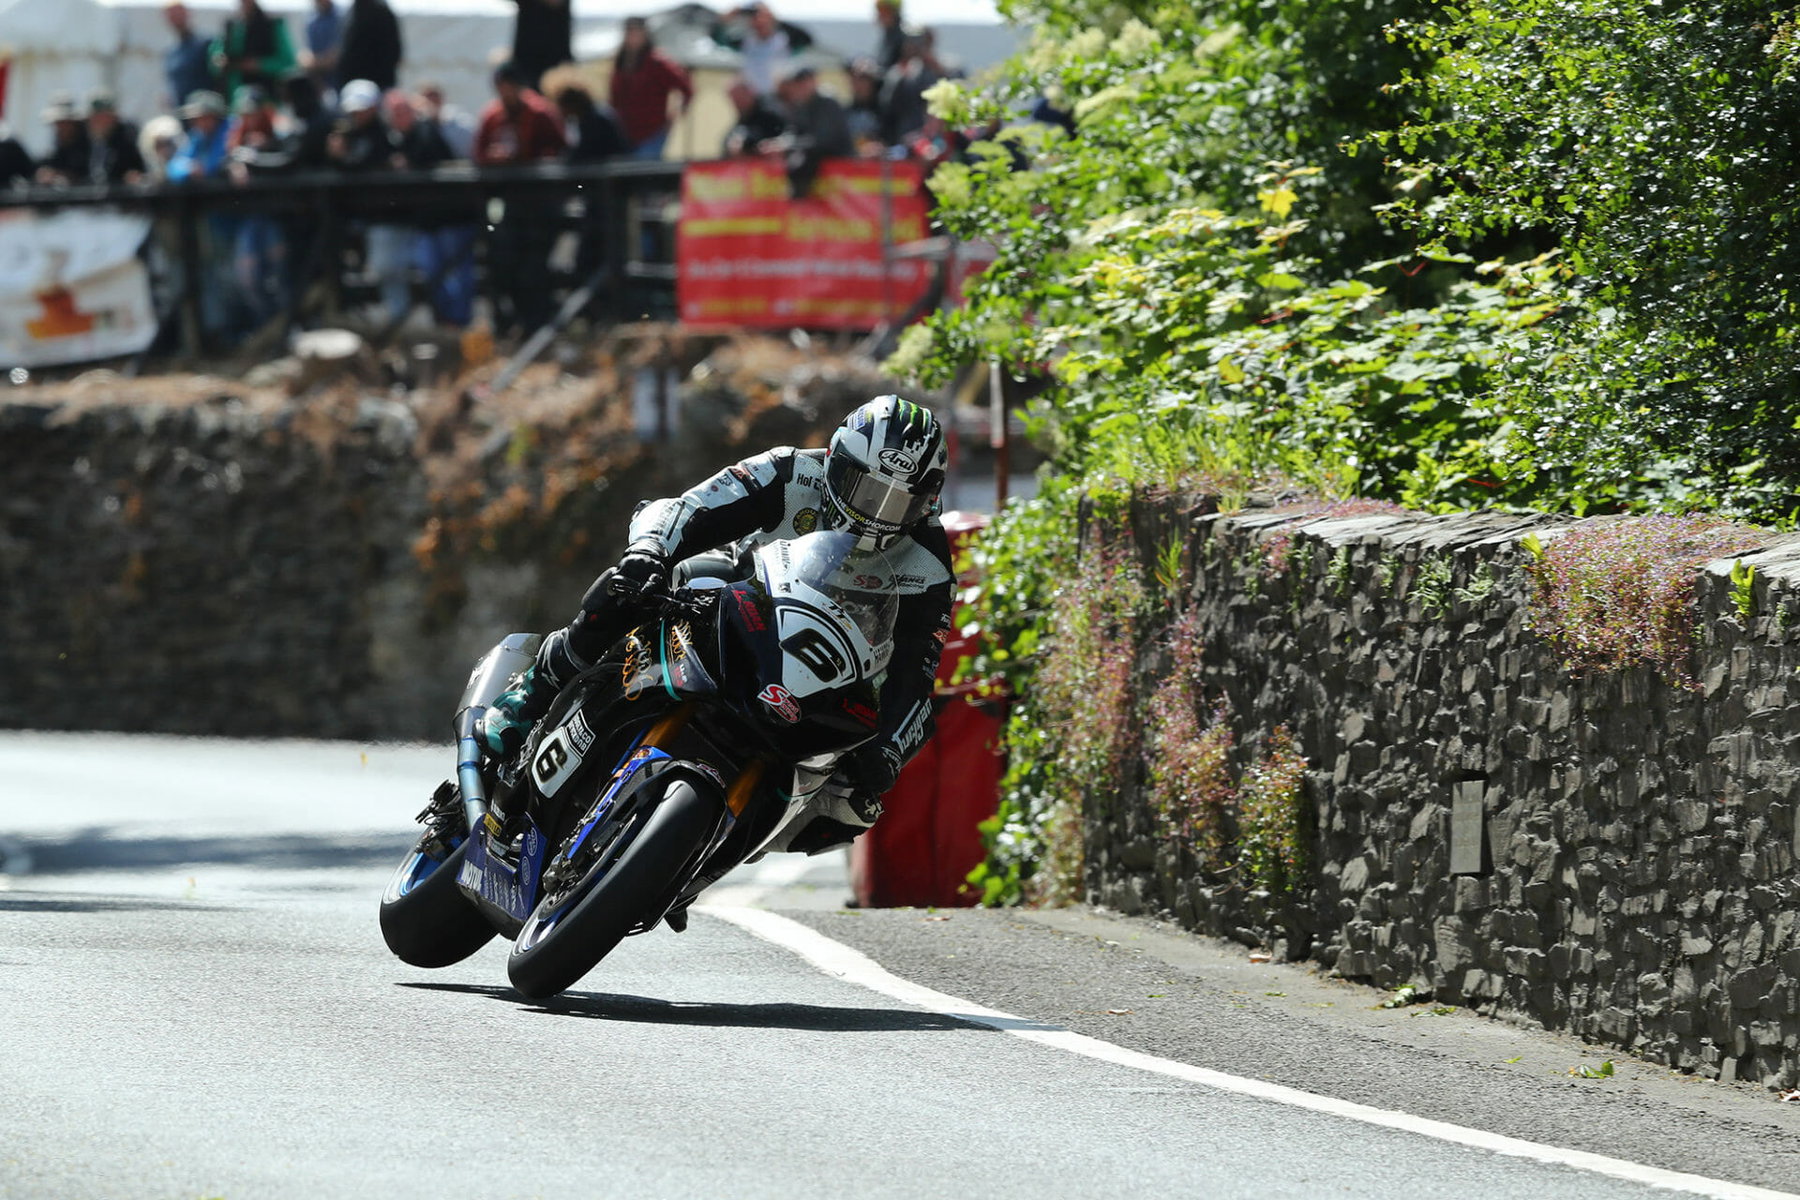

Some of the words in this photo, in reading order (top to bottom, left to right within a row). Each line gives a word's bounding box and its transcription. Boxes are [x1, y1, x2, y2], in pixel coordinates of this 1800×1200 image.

[882, 451, 914, 472] Arai
[779, 628, 847, 683] 6
[536, 737, 568, 783] 6
